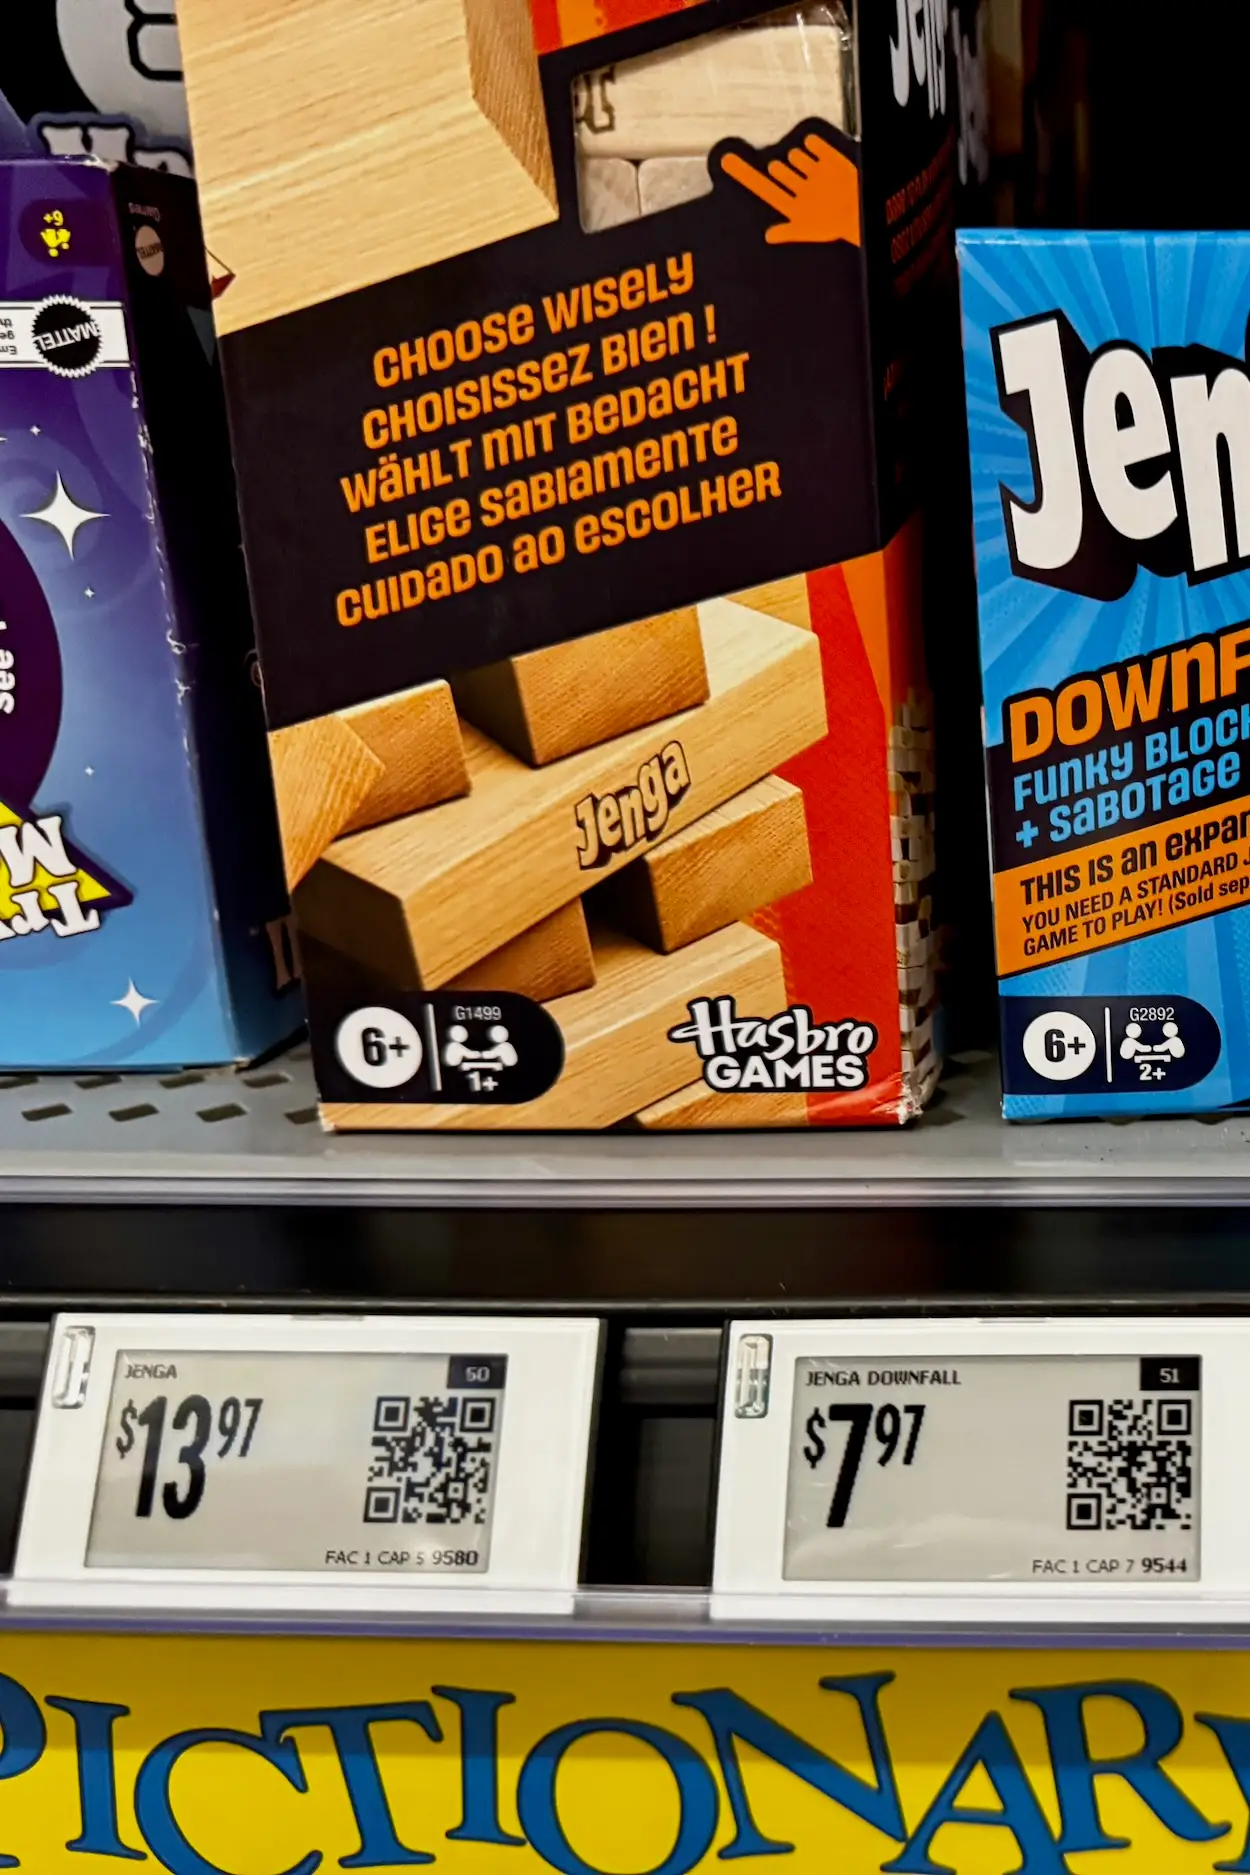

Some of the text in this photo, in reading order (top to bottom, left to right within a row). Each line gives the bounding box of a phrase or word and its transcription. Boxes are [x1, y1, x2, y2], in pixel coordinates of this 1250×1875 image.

[43, 210, 64, 227] 6+
[33, 321, 101, 351] MATTEL
[704, 304, 718, 344] !
[573, 740, 692, 871] Jenga
[1015, 820, 1040, 849] +
[1020, 863, 1081, 906] THIS
[1088, 855, 1114, 886] IS
[1022, 907, 1061, 934] YOU
[1065, 889, 1115, 922] NEED
[1119, 884, 1134, 903] A
[1137, 851, 1239, 900] STANDARD
[1023, 925, 1079, 957] GAME
[1083, 916, 1107, 940] TO
[1112, 897, 1164, 934] PLAY!
[1168, 881, 1214, 917] (Sold
[454, 1005, 503, 1022] G1499
[1128, 1006, 1176, 1023] G2892
[669, 998, 876, 1061] Hasbro
[361, 1026, 412, 1067] 6+
[1043, 1027, 1087, 1064] 6+
[468, 1069, 500, 1093] 1+
[705, 1055, 867, 1089] GAMES
[1139, 1062, 1167, 1082] 2+
[124, 1363, 178, 1381] JENGA
[464, 1366, 490, 1382] 50
[805, 1370, 962, 1387] JENGA DOWNFALL
[1159, 1367, 1181, 1385] 51
[324, 1549, 358, 1565] FAC
[364, 1550, 371, 1564] 1
[377, 1550, 411, 1565] CAP
[432, 1549, 480, 1566] 9580
[1031, 1557, 1188, 1575] FAC 1 CAP 7 9544
